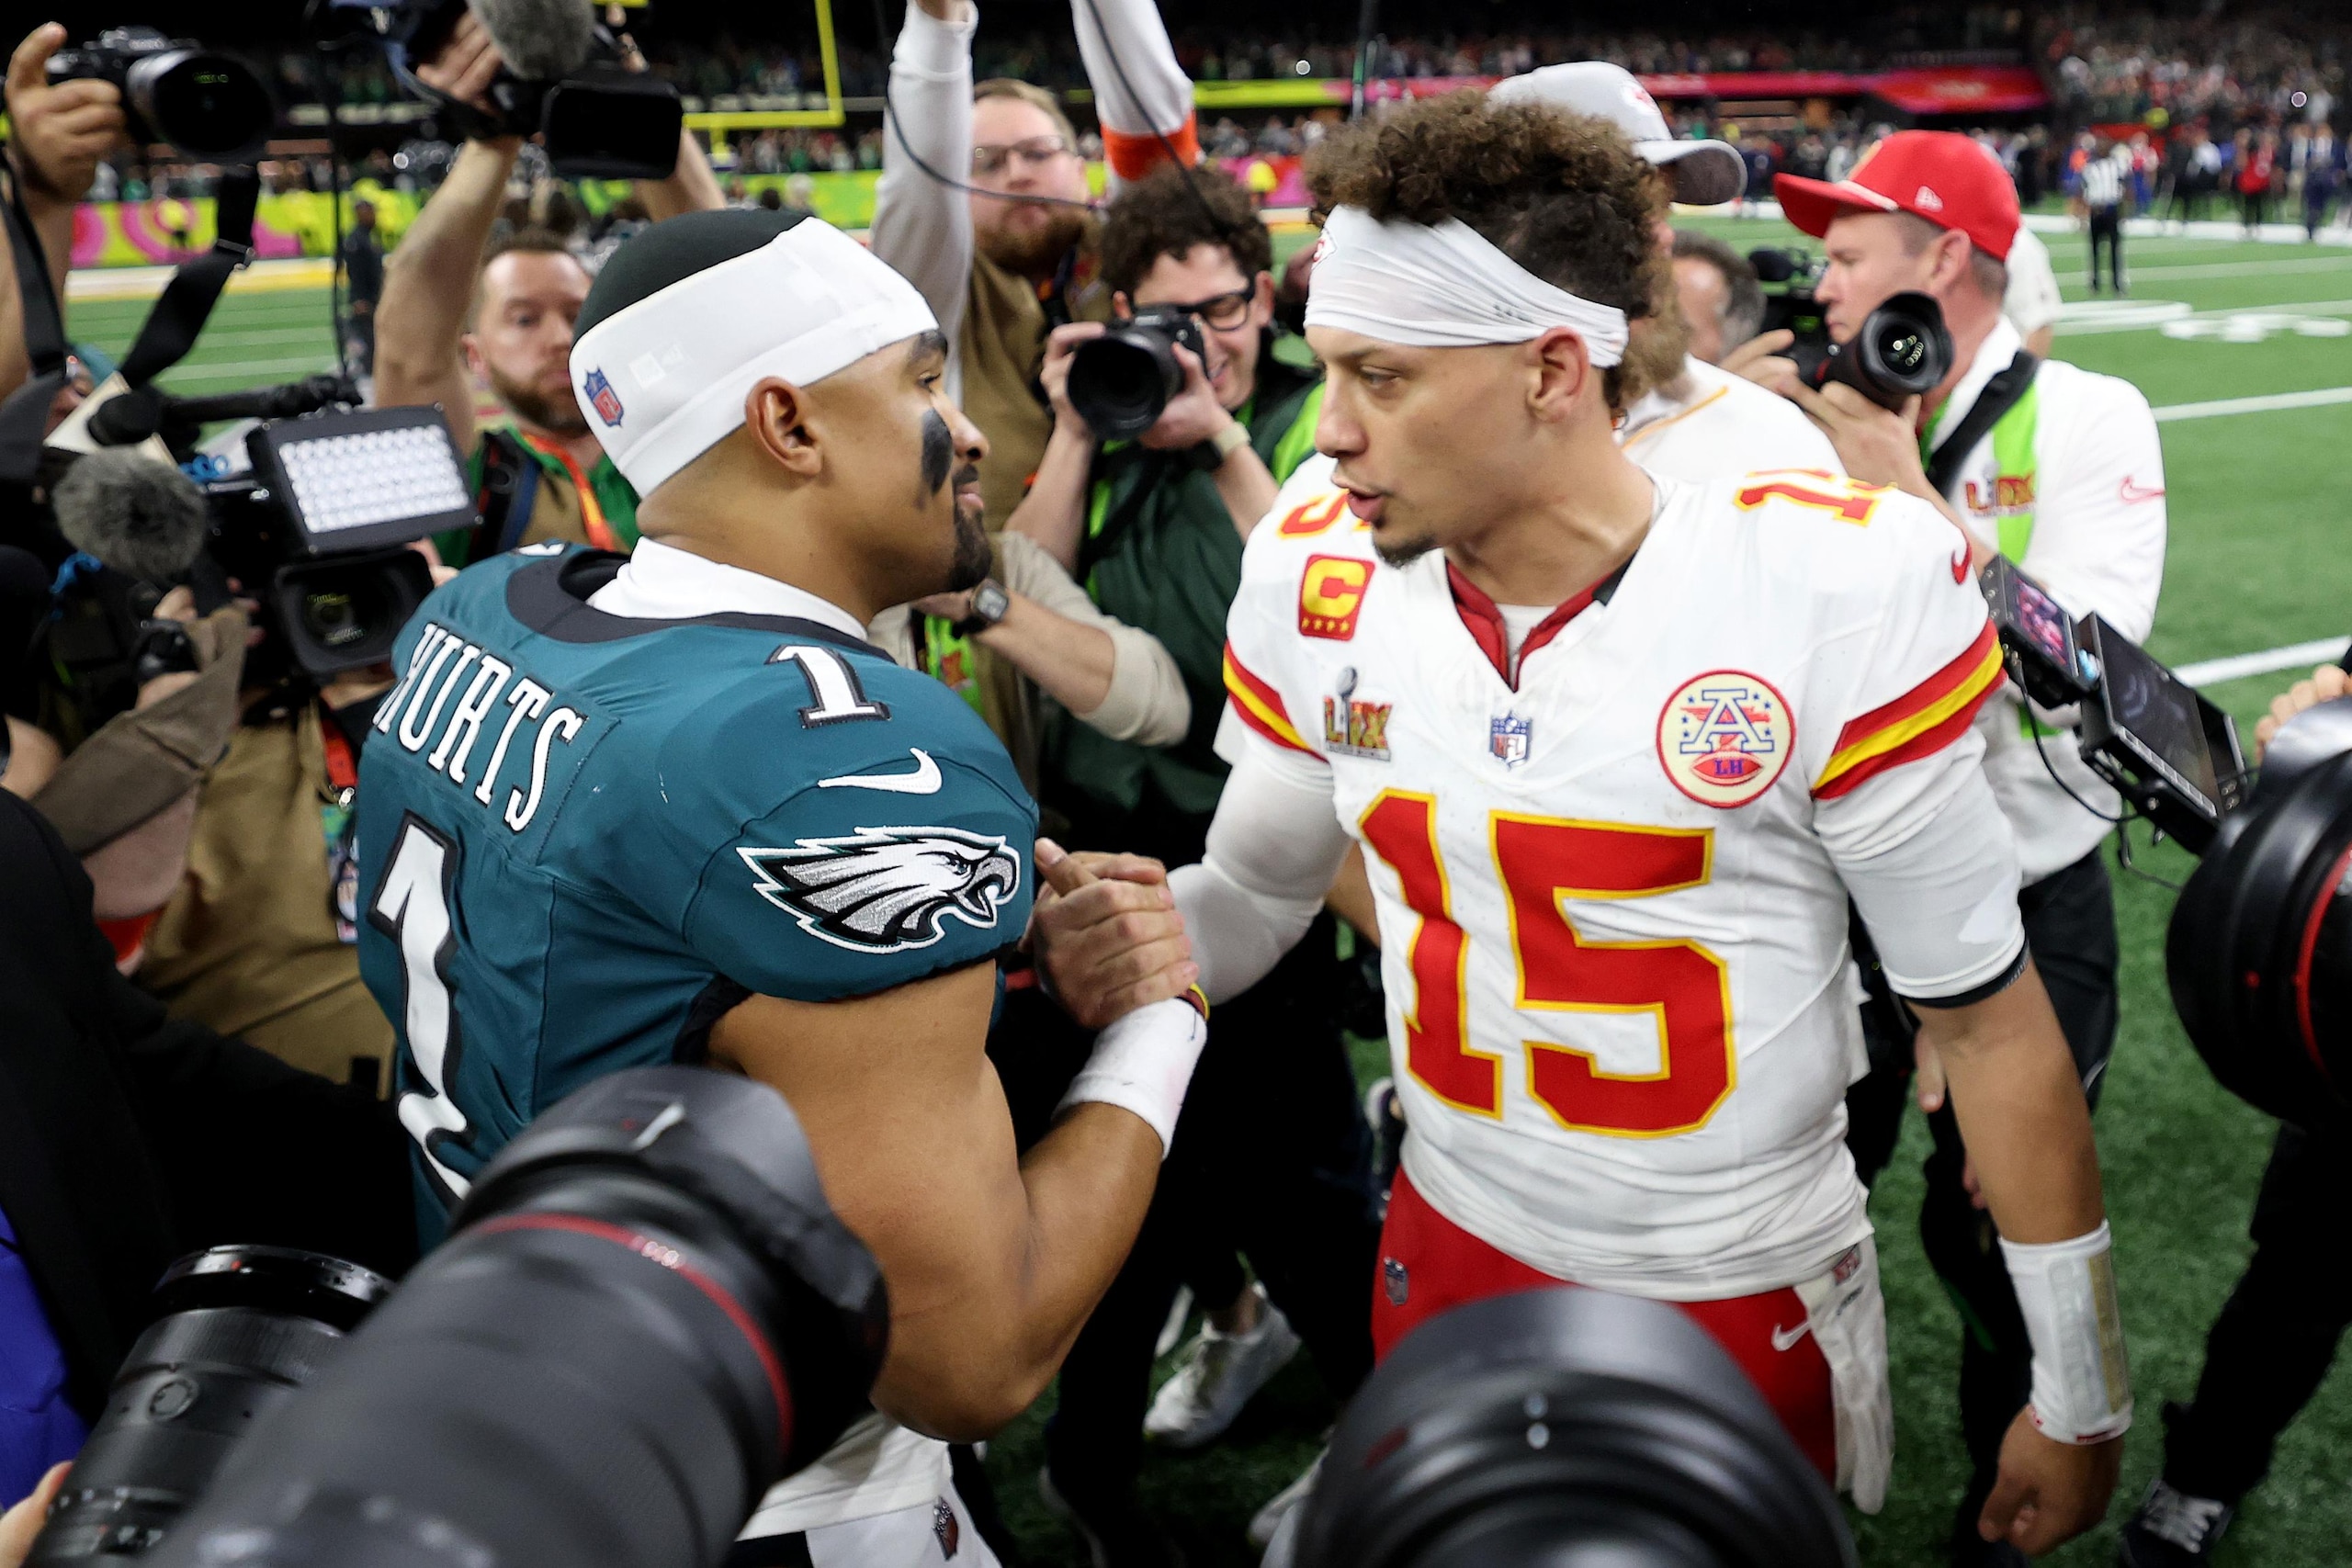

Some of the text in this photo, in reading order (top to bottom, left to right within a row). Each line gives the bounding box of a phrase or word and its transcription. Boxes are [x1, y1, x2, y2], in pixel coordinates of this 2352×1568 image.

[1302, 558, 1367, 619] C
[371, 622, 588, 832] HURTS
[766, 644, 891, 728] 1
[1714, 759, 1745, 776] LH
[1358, 787, 1737, 1138] 15
